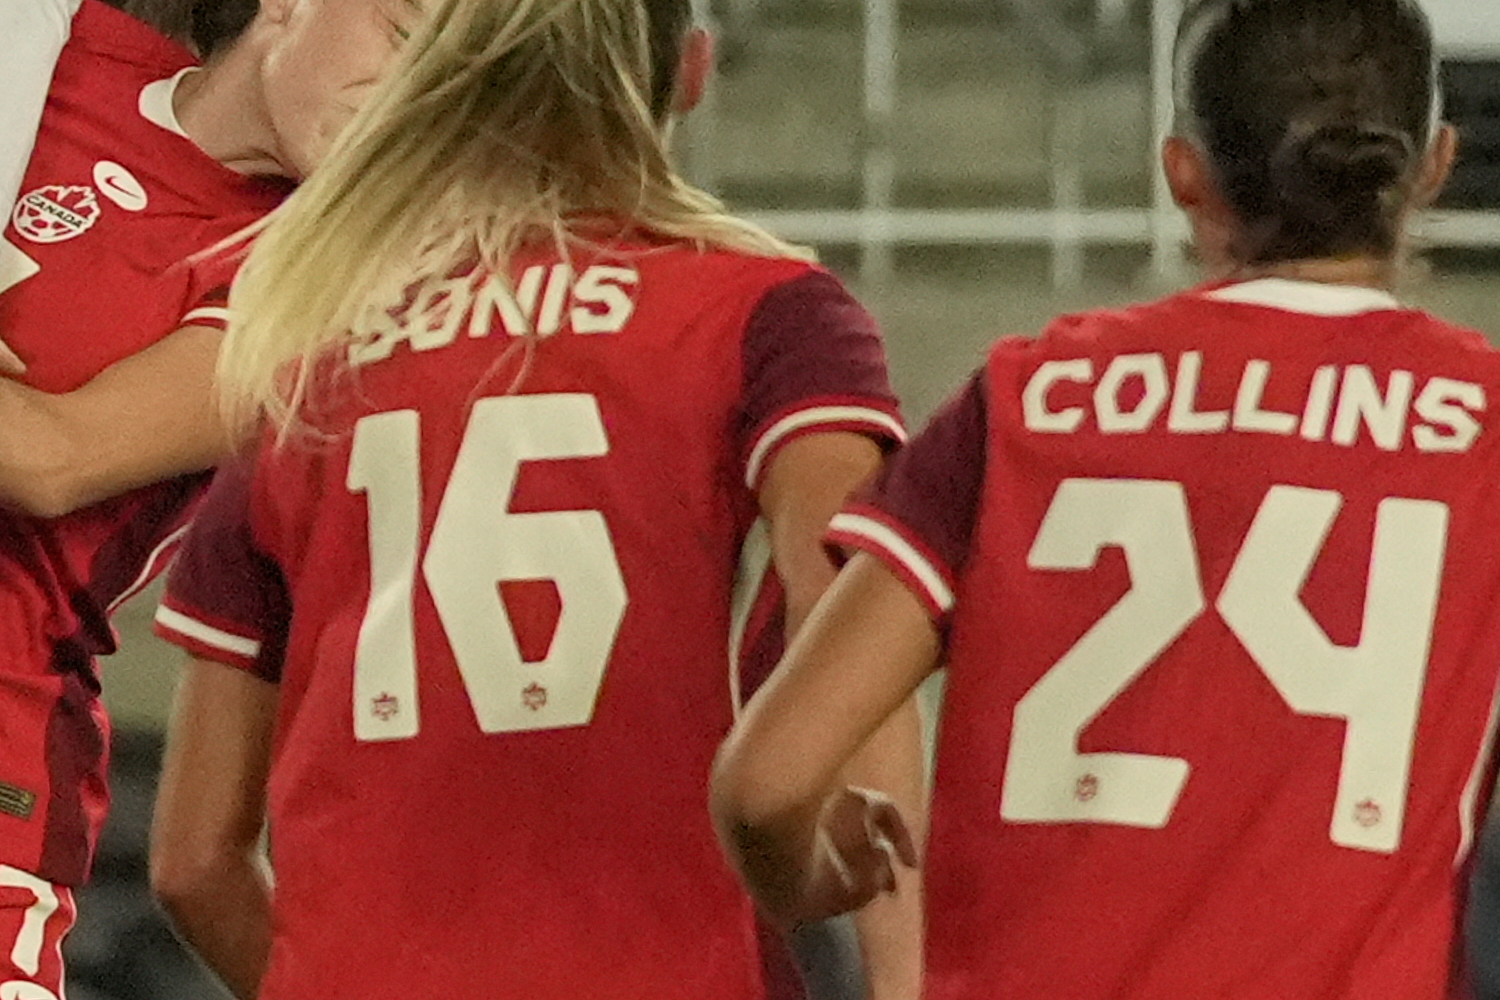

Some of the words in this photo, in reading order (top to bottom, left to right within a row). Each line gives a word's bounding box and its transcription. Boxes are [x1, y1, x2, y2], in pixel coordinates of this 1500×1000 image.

[26, 194, 83, 228] CANADA
[1021, 350, 1487, 454] COLLINS
[346, 393, 629, 742] 16
[999, 477, 1450, 854] 24
